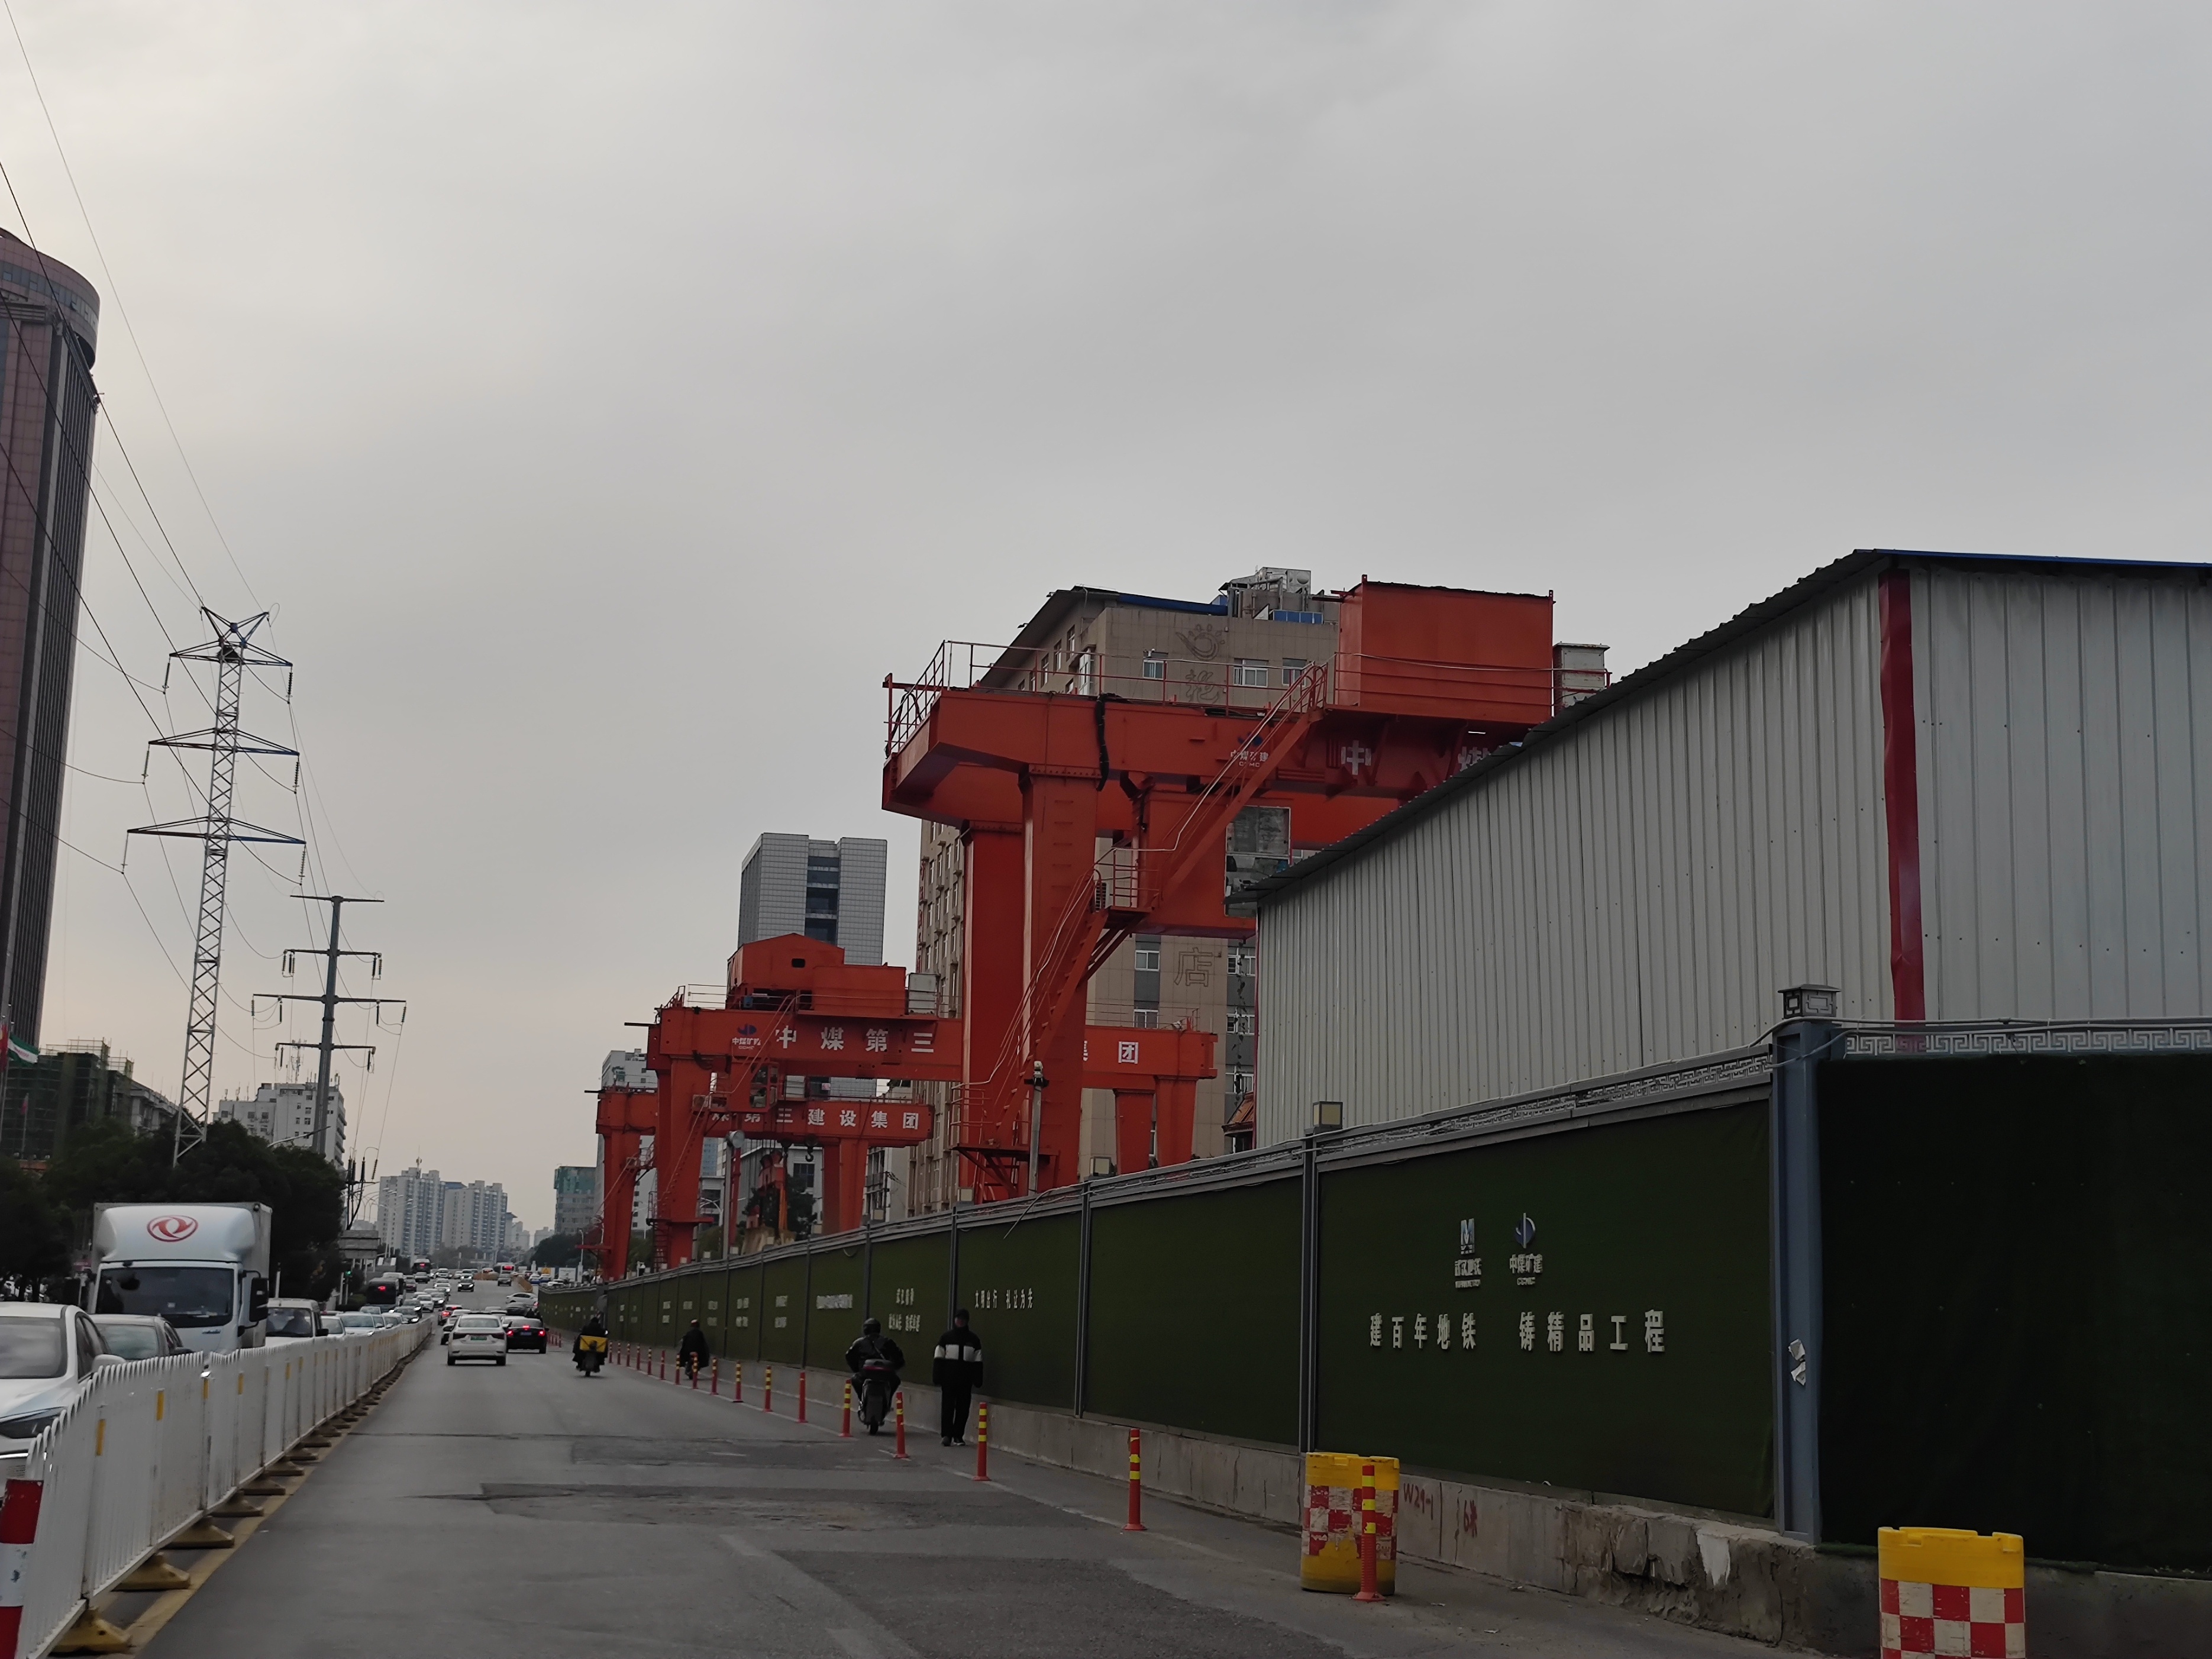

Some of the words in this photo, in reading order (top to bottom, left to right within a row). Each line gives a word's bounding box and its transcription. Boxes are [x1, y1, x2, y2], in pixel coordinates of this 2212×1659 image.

[1174, 947, 1212, 987] 店
[775, 1025, 934, 1053] 中煤第三
[1509, 1253, 1543, 1274] 中煤矿建
[975, 1288, 998, 1309] 文明出行
[1006, 1287, 1034, 1309] 礼让为先
[1370, 1312, 1476, 1350] 建百年地铁
[1519, 1309, 1665, 1353] 铸精品工程
